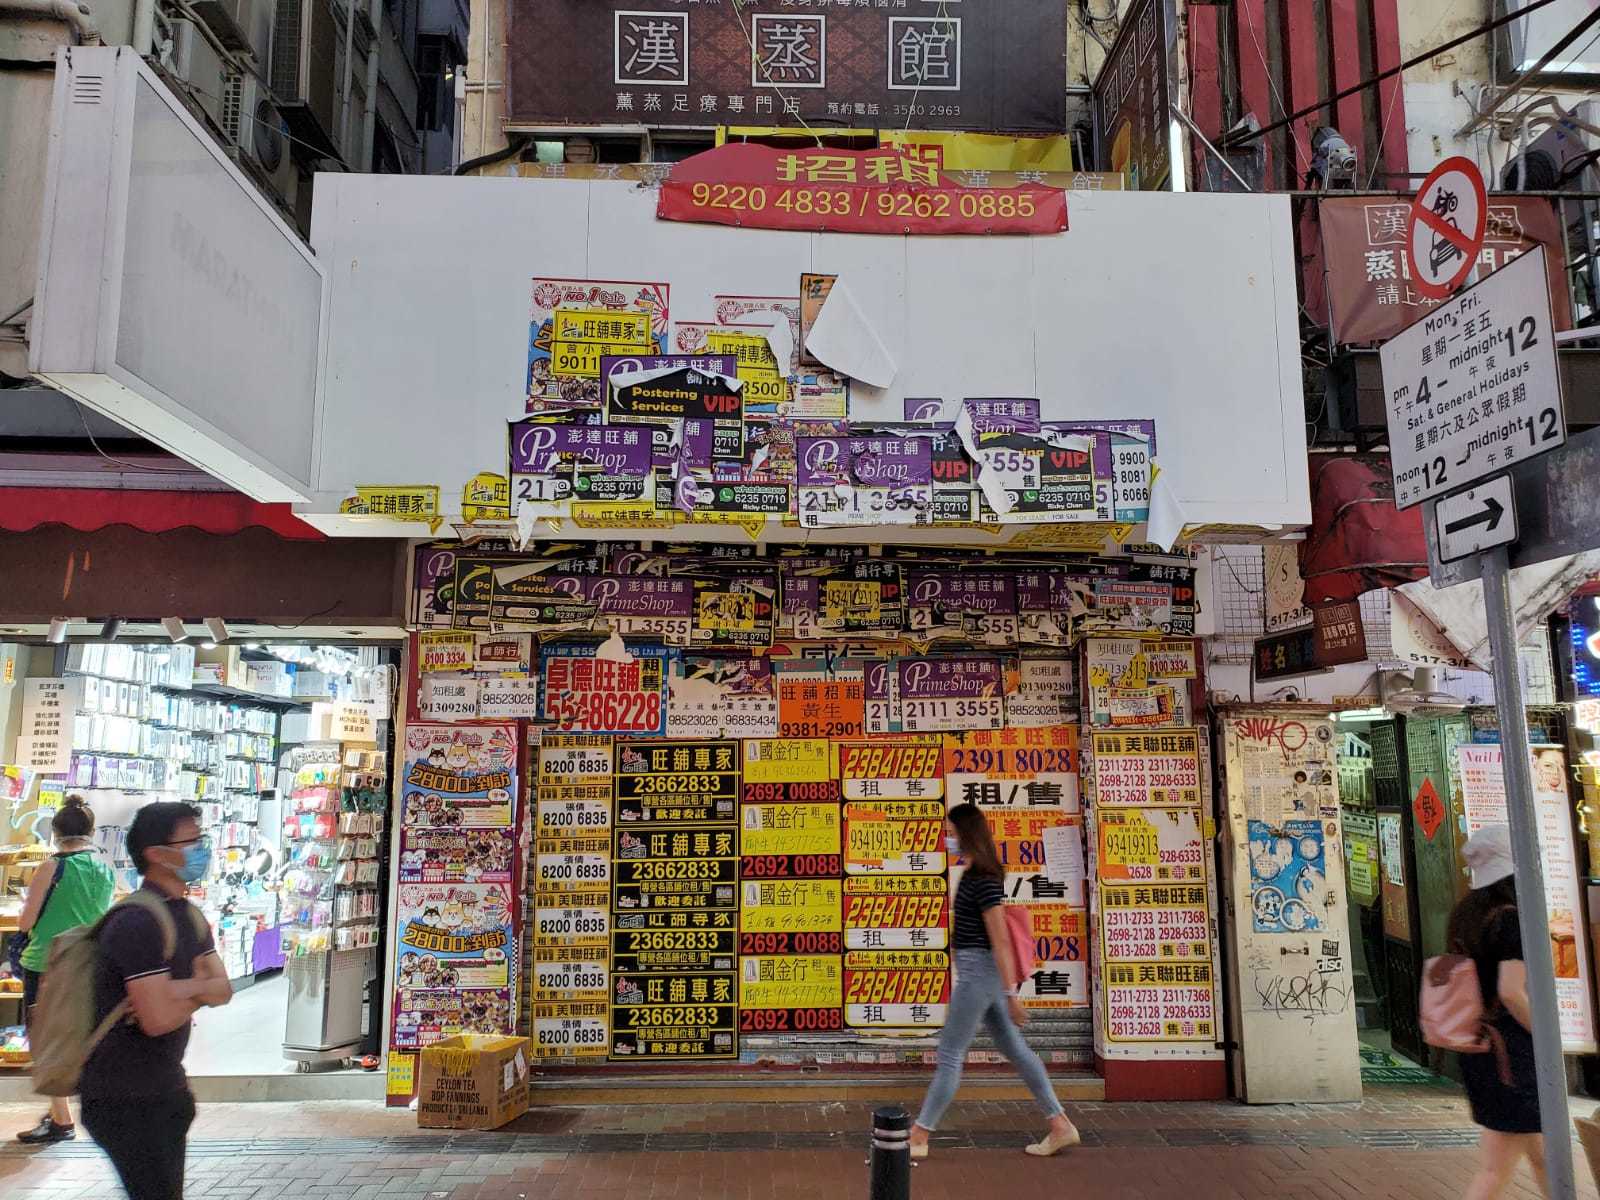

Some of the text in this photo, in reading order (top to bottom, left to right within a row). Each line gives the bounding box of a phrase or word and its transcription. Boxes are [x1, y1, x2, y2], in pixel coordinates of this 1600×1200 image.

[929, 104, 961, 116] 2963
[691, 183, 767, 210] 9220
[775, 186, 851, 215] 4833
[877, 193, 951, 218] 9262
[959, 194, 1036, 218] 0885
[1420, 309, 1493, 366] 星期一至五
[1448, 315, 1538, 370] midnight 12
[559, 355, 597, 371] 9011
[1468, 355, 1498, 378] 午夜
[631, 386, 698, 401] Postering
[1392, 375, 1432, 405] pm 4
[1427, 408, 1435, 420] &
[1436, 384, 1478, 414] General
[1479, 360, 1530, 394] Holidays
[631, 395, 740, 413] Services VIP
[1393, 399, 1414, 418] 下午
[714, 437, 739, 447] 0710
[1396, 407, 1559, 490] noon 12 midnight 12
[1050, 451, 1089, 469] VIP
[1119, 451, 1146, 466] 9900
[1487, 444, 1515, 468] 午夜
[932, 460, 969, 479] VIP
[1121, 470, 1147, 484] 8081
[590, 481, 617, 493] 6235
[1122, 488, 1149, 502] 6066
[1400, 485, 1422, 502] 中午
[735, 493, 786, 504] 6235 0710
[1039, 492, 1091, 502] 6235 0710
[943, 502, 969, 512] 0710
[641, 619, 688, 634] 3555
[905, 661, 984, 693] PrimeShop
[1021, 681, 1072, 692] 91309280
[421, 702, 476, 713] 91309280
[482, 693, 535, 705] 98523026
[906, 700, 999, 718] 2111 3555
[1009, 705, 1058, 716] 98523026
[668, 714, 718, 726] 98523026
[725, 714, 776, 726] 96835434
[782, 722, 863, 737] 9381-2901
[760, 741, 800, 761] 國金行
[1125, 736, 1195, 753] 美聯旺舖
[545, 759, 608, 773] 8200 6835
[652, 747, 732, 770] 旺舖專家
[843, 748, 945, 779] 23841838
[952, 748, 1072, 773] 2391 8028
[633, 775, 721, 793] 23662833
[860, 780, 926, 797] 租 售
[1099, 774, 1197, 787] 2698-2128 2928-6333
[745, 783, 829, 801] 2692 0088
[1100, 789, 1147, 802] 2813-2628
[543, 811, 607, 826] 8200 6835
[761, 806, 807, 829] 國金行
[651, 833, 732, 857] 旺舖專家
[1106, 834, 1159, 856] 93419313
[631, 861, 720, 879] 23662833
[743, 856, 840, 876] 2692 0088
[907, 854, 929, 871] 售
[760, 883, 808, 907] 國金行
[1134, 888, 1205, 905] 美聯旺舖
[844, 896, 945, 929] 23841838
[540, 919, 605, 933] 8200 6835
[1107, 927, 1207, 941] 2698-2128 2928-6333
[629, 932, 719, 950] 23662833
[743, 933, 840, 953] 2692 0088
[862, 929, 930, 947] 租 售
[1108, 944, 1157, 957] 2813-2628
[759, 958, 808, 981] 國金行
[1139, 965, 1210, 982] 美聯旺舖
[648, 978, 731, 1002] 旺舖專家
[845, 971, 947, 1004] 23841838
[628, 1007, 719, 1026] 23662833
[742, 1010, 841, 1030] 2692 0088
[863, 1005, 931, 1023] 租 售
[1111, 1005, 1211, 1019] 2698-2128 2928-6333
[539, 1029, 604, 1044] 8200 6835
[1111, 1022, 1161, 1035] 2813-2628
[436, 1078, 476, 1090] CEYLON TEA
